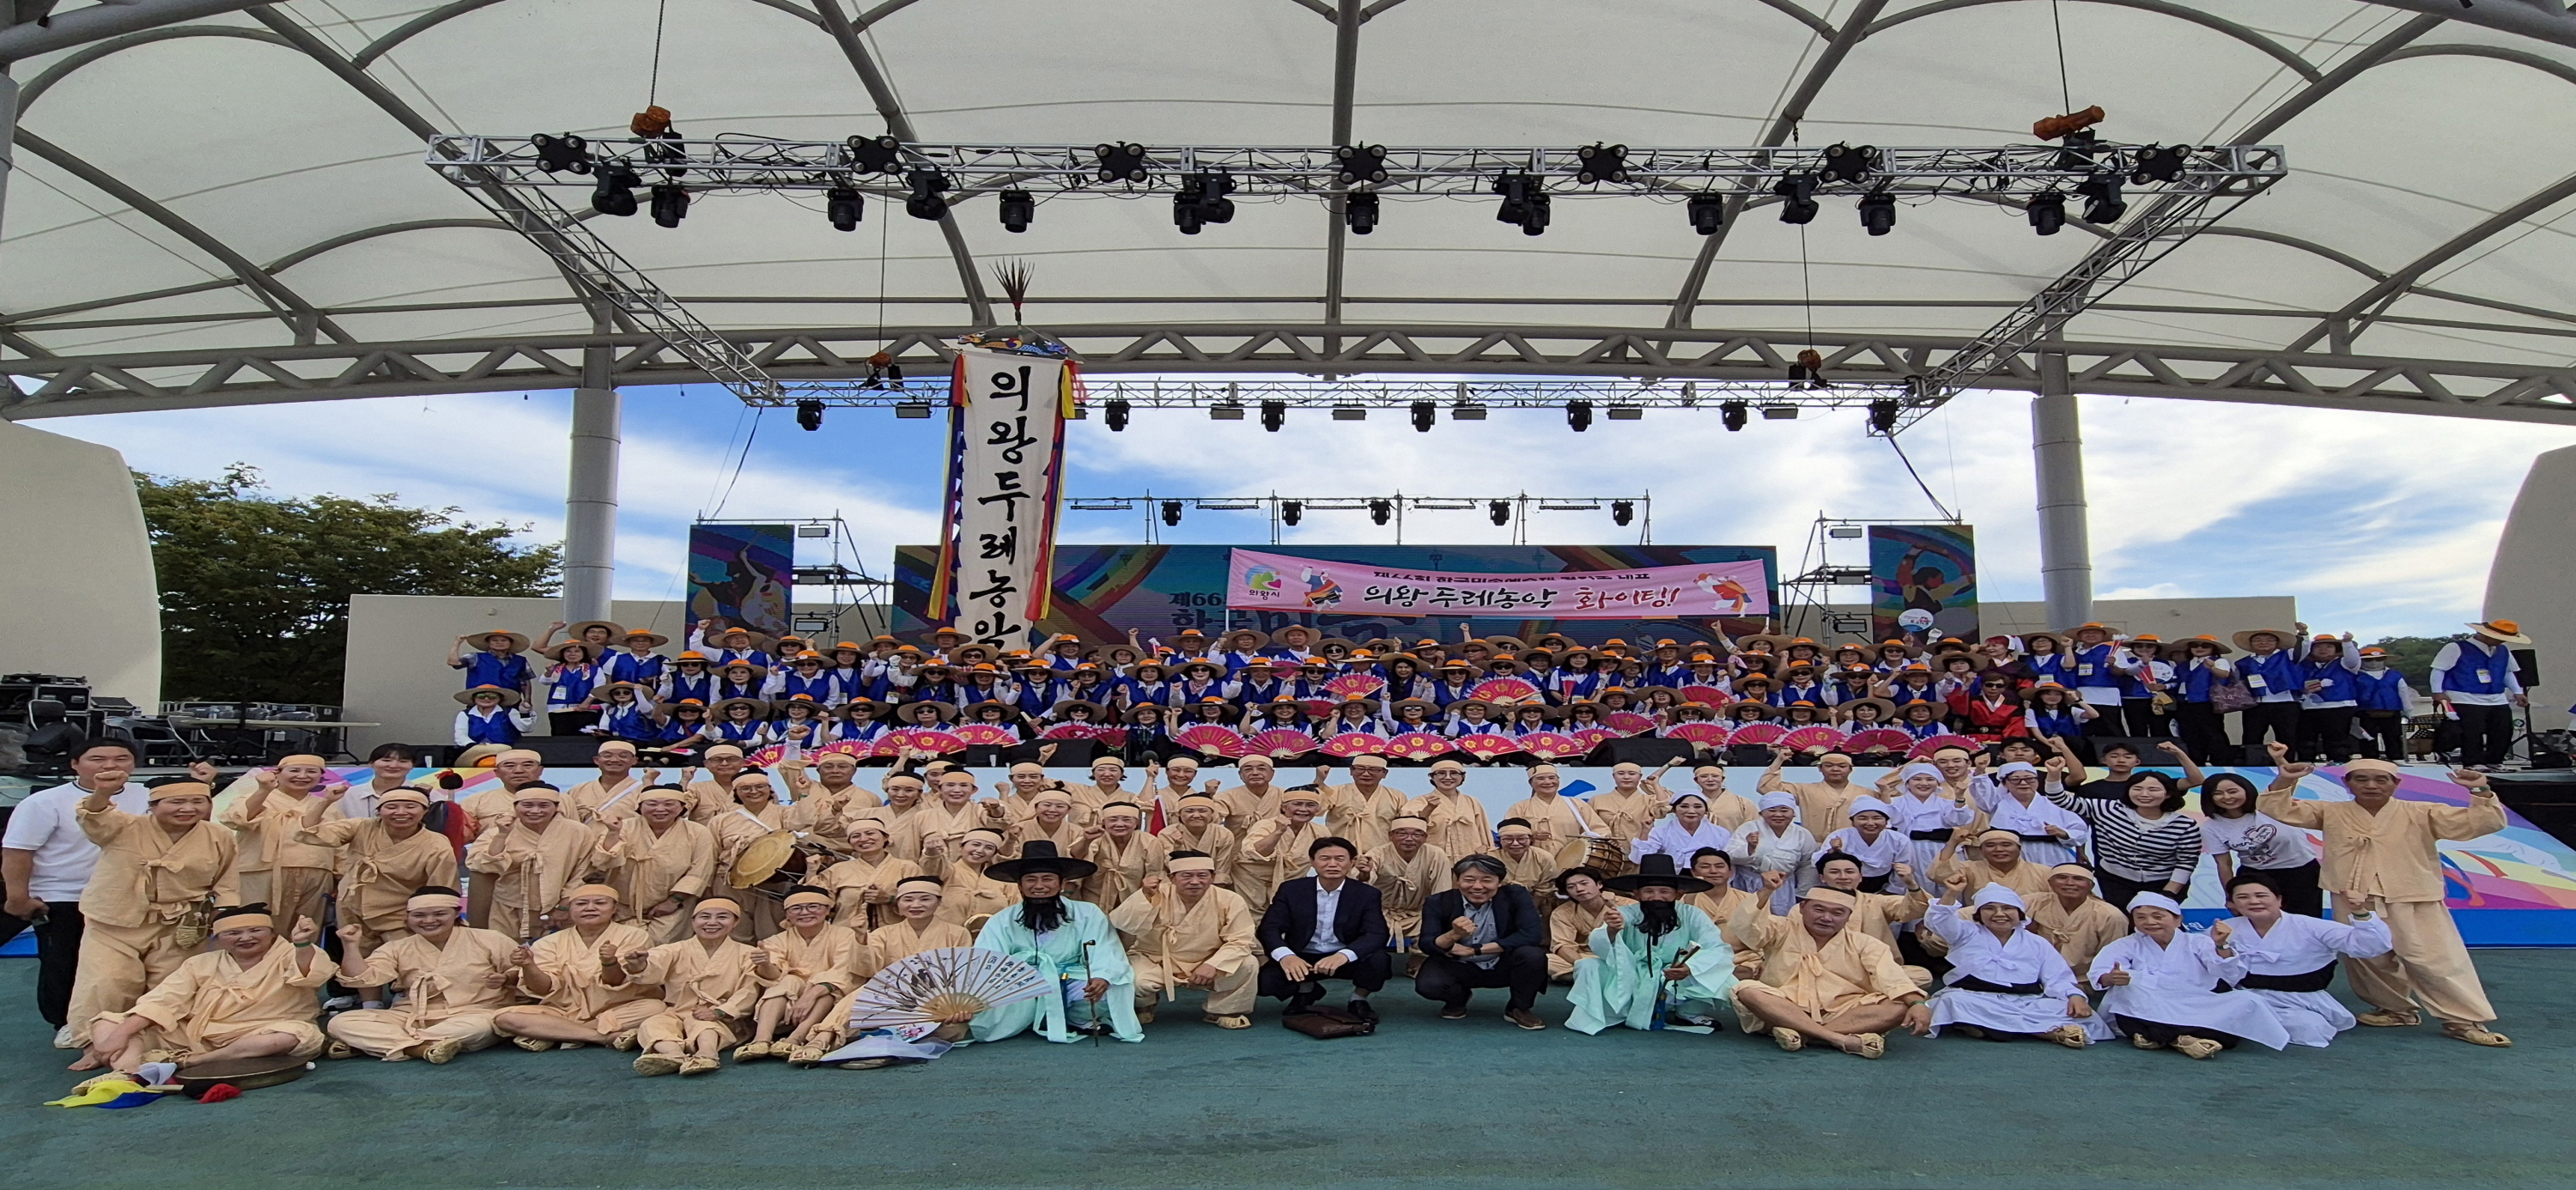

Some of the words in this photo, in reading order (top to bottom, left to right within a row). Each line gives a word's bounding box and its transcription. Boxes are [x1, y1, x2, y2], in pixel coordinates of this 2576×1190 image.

[1169, 592, 1227, 607] 제66
[1249, 589, 1280, 601] 의왕시
[1574, 586, 1680, 610] 화이팅!
